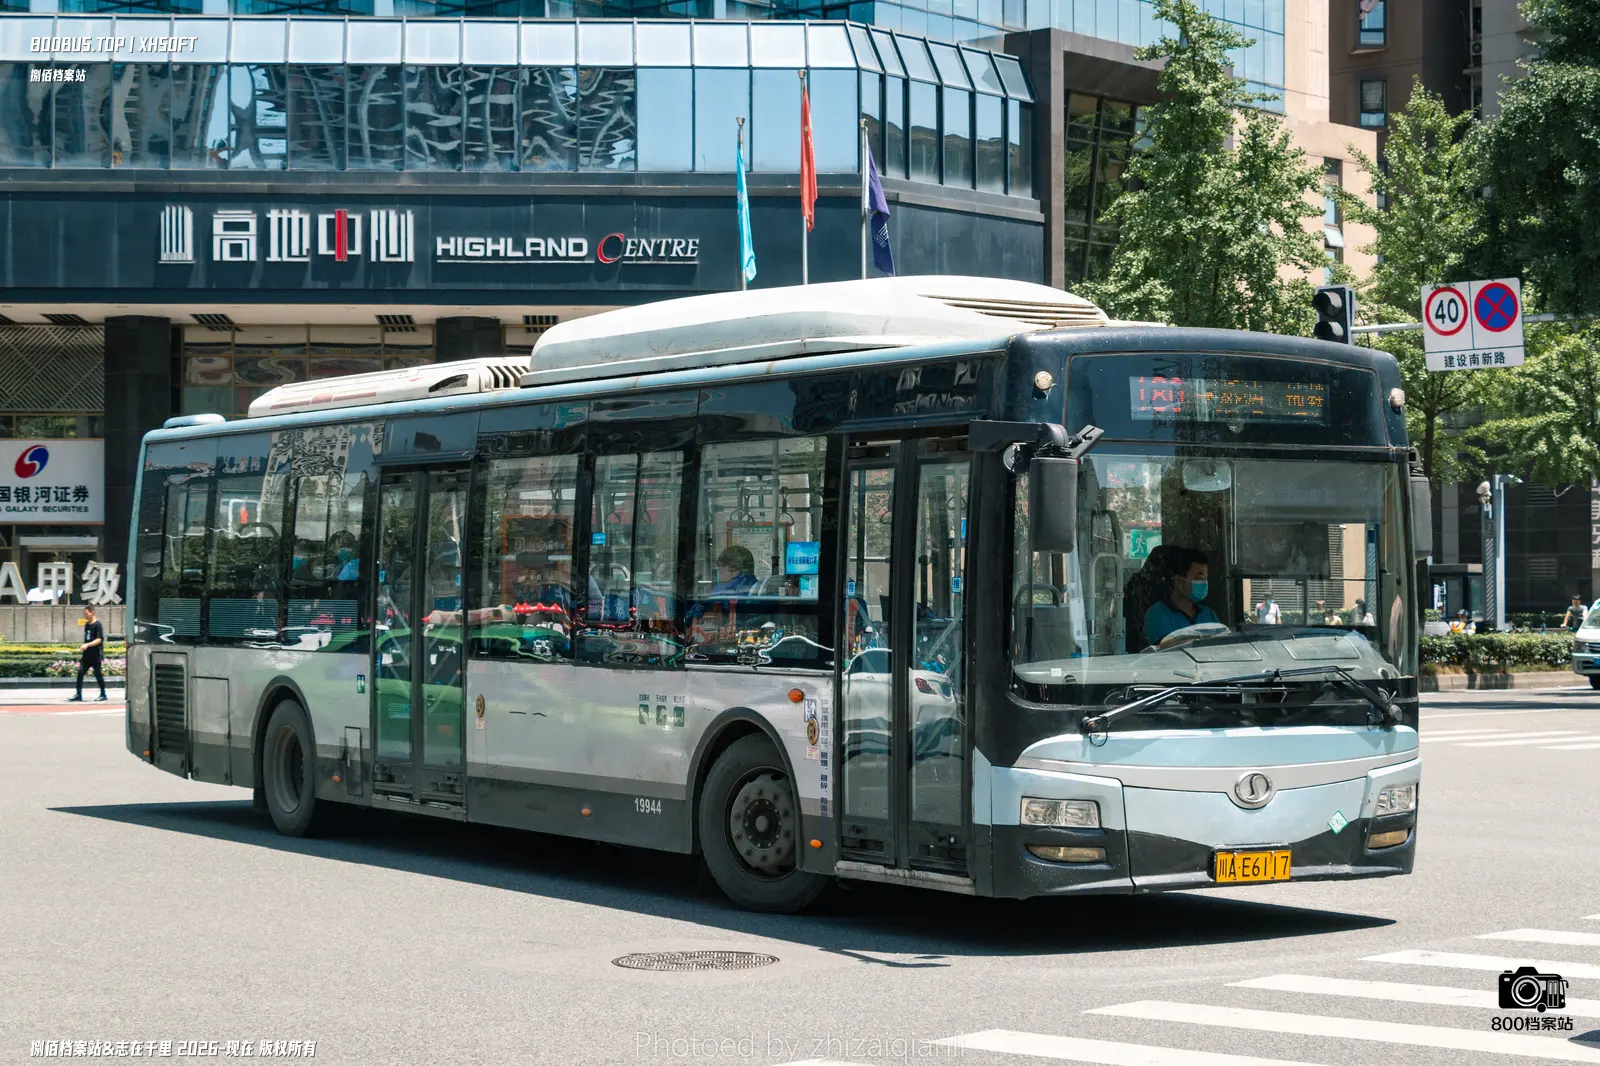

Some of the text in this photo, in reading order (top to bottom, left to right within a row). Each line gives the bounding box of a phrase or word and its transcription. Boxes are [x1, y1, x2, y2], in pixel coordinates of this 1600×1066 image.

[212, 208, 415, 262] 高地中心
[436, 232, 699, 264] HIGHLAND CENTRE
[1434, 297, 1459, 325] 40
[1444, 351, 1506, 368] 建设南新路
[0, 485, 90, 503] 国银河证券
[42, 505, 89, 513] SECURITIES
[634, 797, 662, 815] 19944
